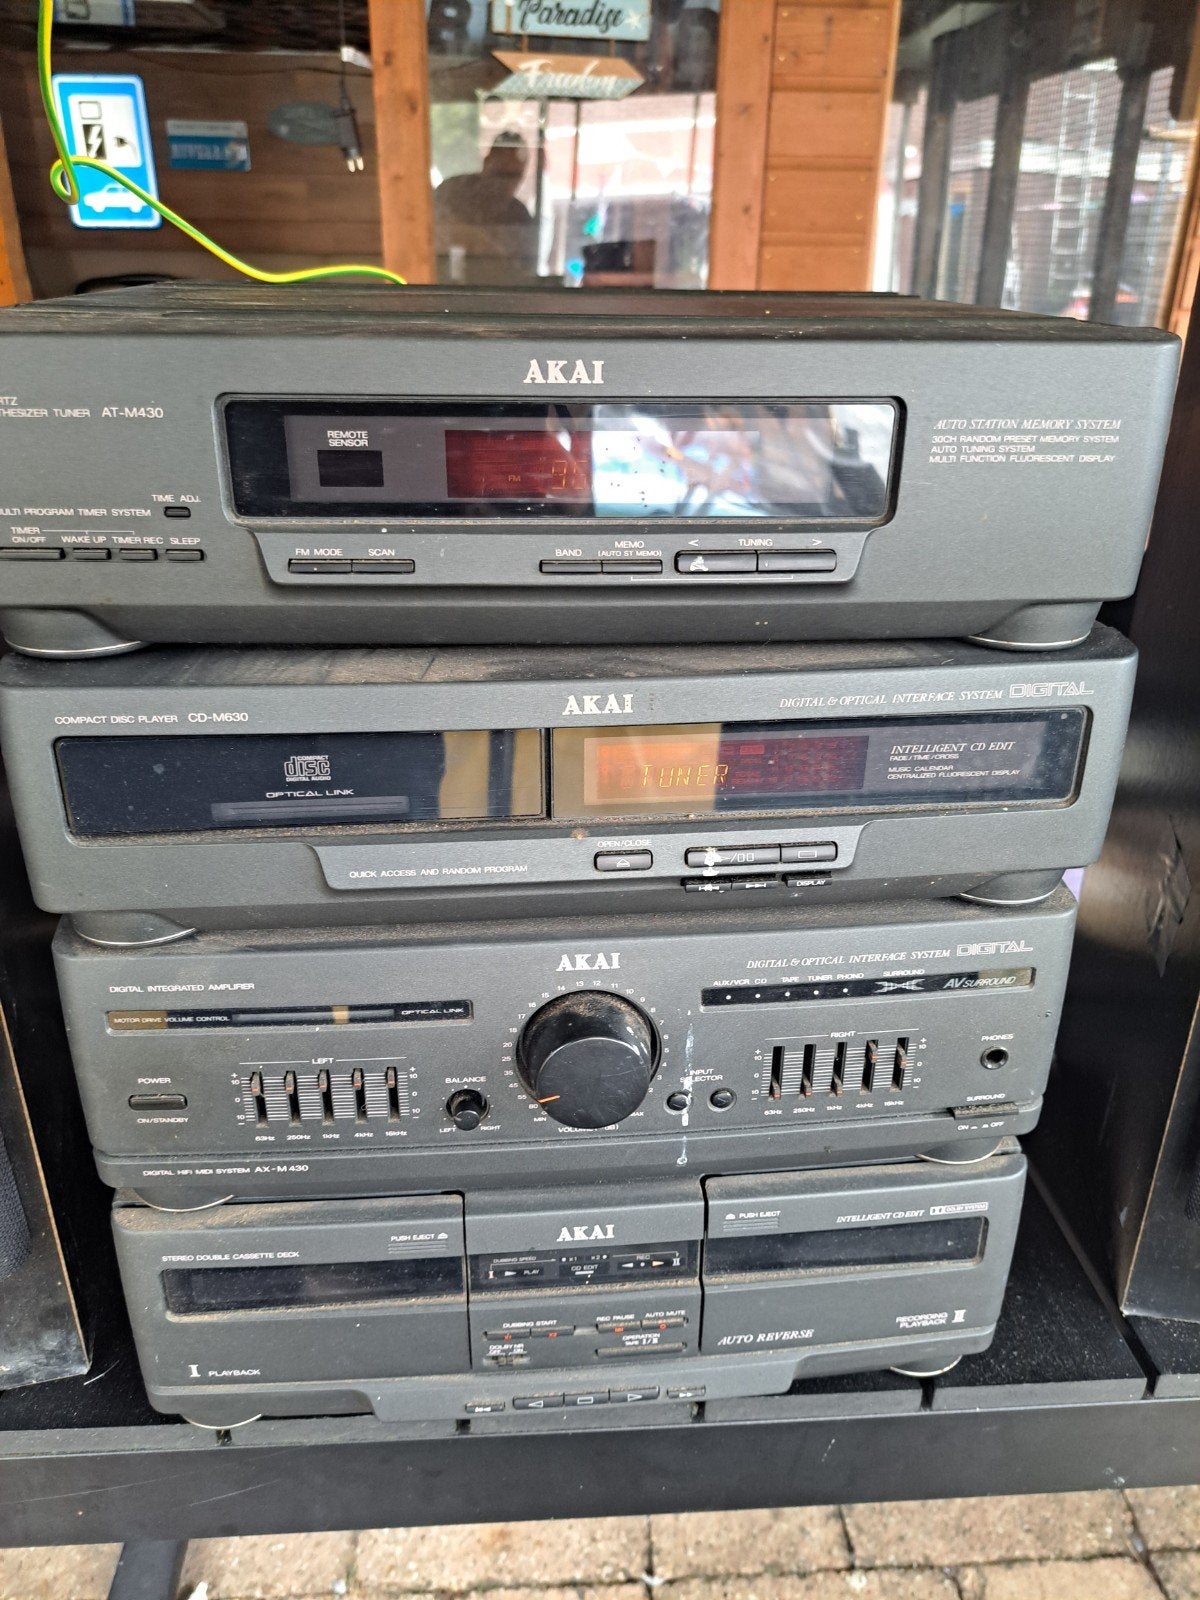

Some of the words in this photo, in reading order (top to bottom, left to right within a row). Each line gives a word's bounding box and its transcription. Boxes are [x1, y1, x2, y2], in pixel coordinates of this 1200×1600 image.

[518, 0, 625, 33] Paradise
[523, 359, 604, 384] AKAI
[53, 408, 91, 418] TUNER
[101, 407, 164, 419] AT-M430
[933, 420, 967, 430] AUTO
[969, 420, 1019, 429] STATION
[1021, 420, 1074, 429] MEMORY
[1075, 420, 1121, 430] SYSTEM
[327, 431, 369, 439] REMOTE
[960, 435, 1001, 443] RANDOM
[1004, 435, 1038, 443] PRESET
[1040, 435, 1080, 443] MEMORY
[1083, 435, 1119, 443] SYSTEM
[329, 439, 369, 448] SENSOR
[931, 445, 957, 453] AUTO
[962, 445, 995, 453] TUNING
[999, 445, 1035, 453] SYSTEM
[929, 455, 956, 463] MULTI
[960, 455, 1006, 463] FUNCTION
[1010, 455, 1075, 463] FLUORESCENT
[1079, 455, 1115, 463] DISPLAY
[152, 494, 175, 503] TIME
[180, 494, 202, 503] ADJ.
[24, 508, 74, 516] PROGRAM
[78, 508, 107, 516] TIMER
[112, 508, 151, 517] SYSTEM
[11, 527, 40, 535] TIMER
[61, 535, 90, 543] WAKE
[112, 536, 141, 544] TIMER
[614, 540, 645, 549] MEMO
[738, 538, 773, 548] TUNING
[555, 549, 582, 557] BAND
[1009, 682, 1094, 698] DIGITAL
[562, 693, 634, 715] AKAI
[780, 696, 826, 708] DIGITAL
[828, 697, 838, 706] &
[839, 696, 887, 705] OPTICAL
[892, 694, 955, 703] INTERFACE
[959, 690, 1003, 700] SYSTEM
[55, 717, 106, 725] COMPACT
[111, 717, 135, 725] DISC
[188, 713, 248, 722] CD-M630
[891, 743, 967, 754] INTELLIGENT
[970, 742, 985, 751] CD
[989, 742, 1015, 751] EDIT
[284, 756, 330, 776] disc
[641, 764, 728, 788] TUNER
[957, 941, 1033, 956] DIGITAL
[556, 953, 620, 971] AKAI
[747, 957, 788, 968] DIGITAL
[790, 958, 800, 966] &
[801, 956, 845, 965] OPTICAL
[849, 953, 906, 962] INTERFACE
[910, 950, 950, 959] SYSTEM
[943, 978, 964, 988] AV
[965, 976, 1016, 987] SURROUND
[966, 1093, 1005, 1102] SURROUND
[837, 1213, 890, 1223] INTELLIGENT
[904, 1209, 925, 1217] EDIT
[557, 1225, 615, 1241] AKAI
[896, 1312, 948, 1324] RECORDING
[900, 1319, 946, 1328] PLAYBACK
[623, 1333, 660, 1341] OPERATION
[718, 1334, 753, 1345] AUTO
[757, 1329, 814, 1342] REVERSE
